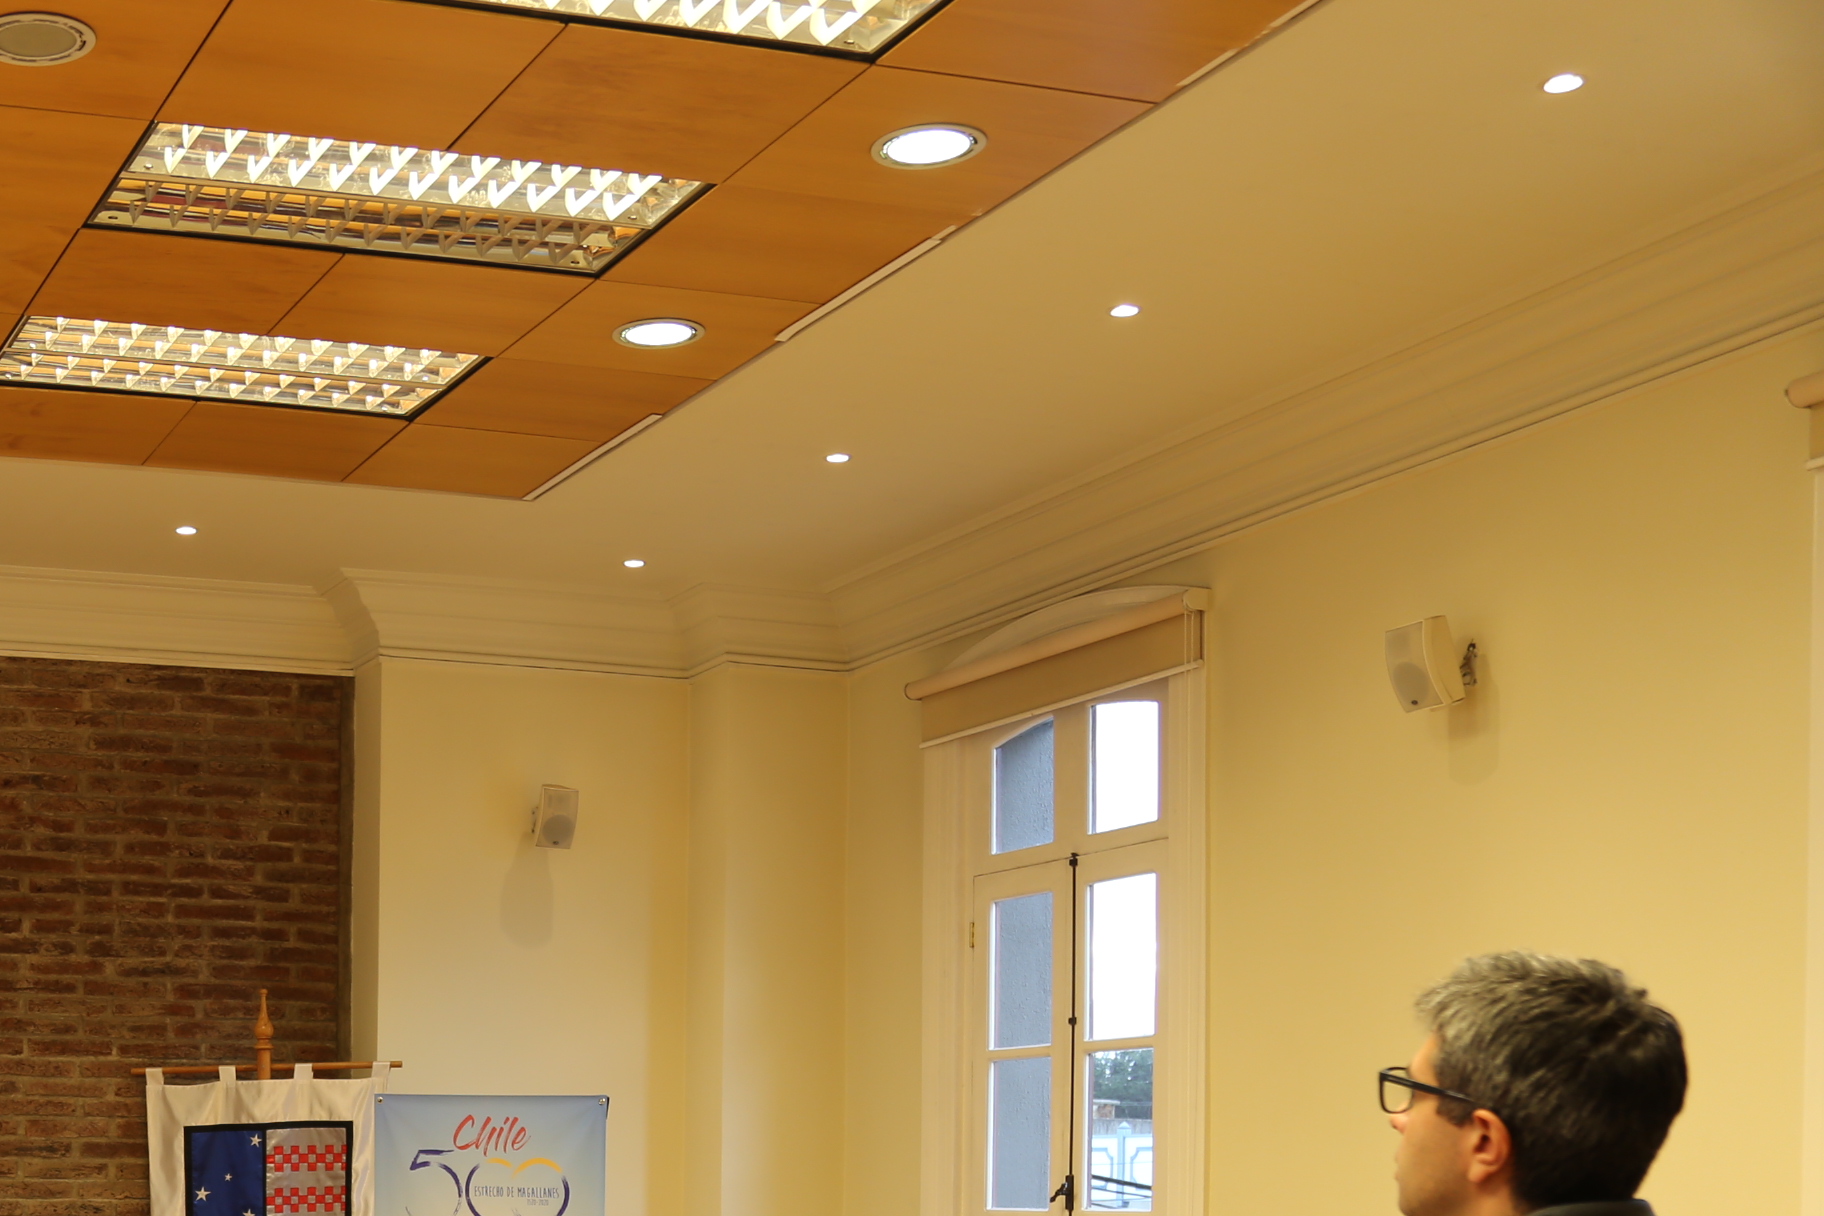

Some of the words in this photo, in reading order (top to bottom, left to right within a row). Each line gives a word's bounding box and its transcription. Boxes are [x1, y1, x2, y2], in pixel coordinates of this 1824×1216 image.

[453, 1114, 532, 1157] Chile
[474, 1186, 504, 1197] ESTRECHO
[507, 1187, 514, 1197] DE
[517, 1187, 560, 1199] MAGALLANES
